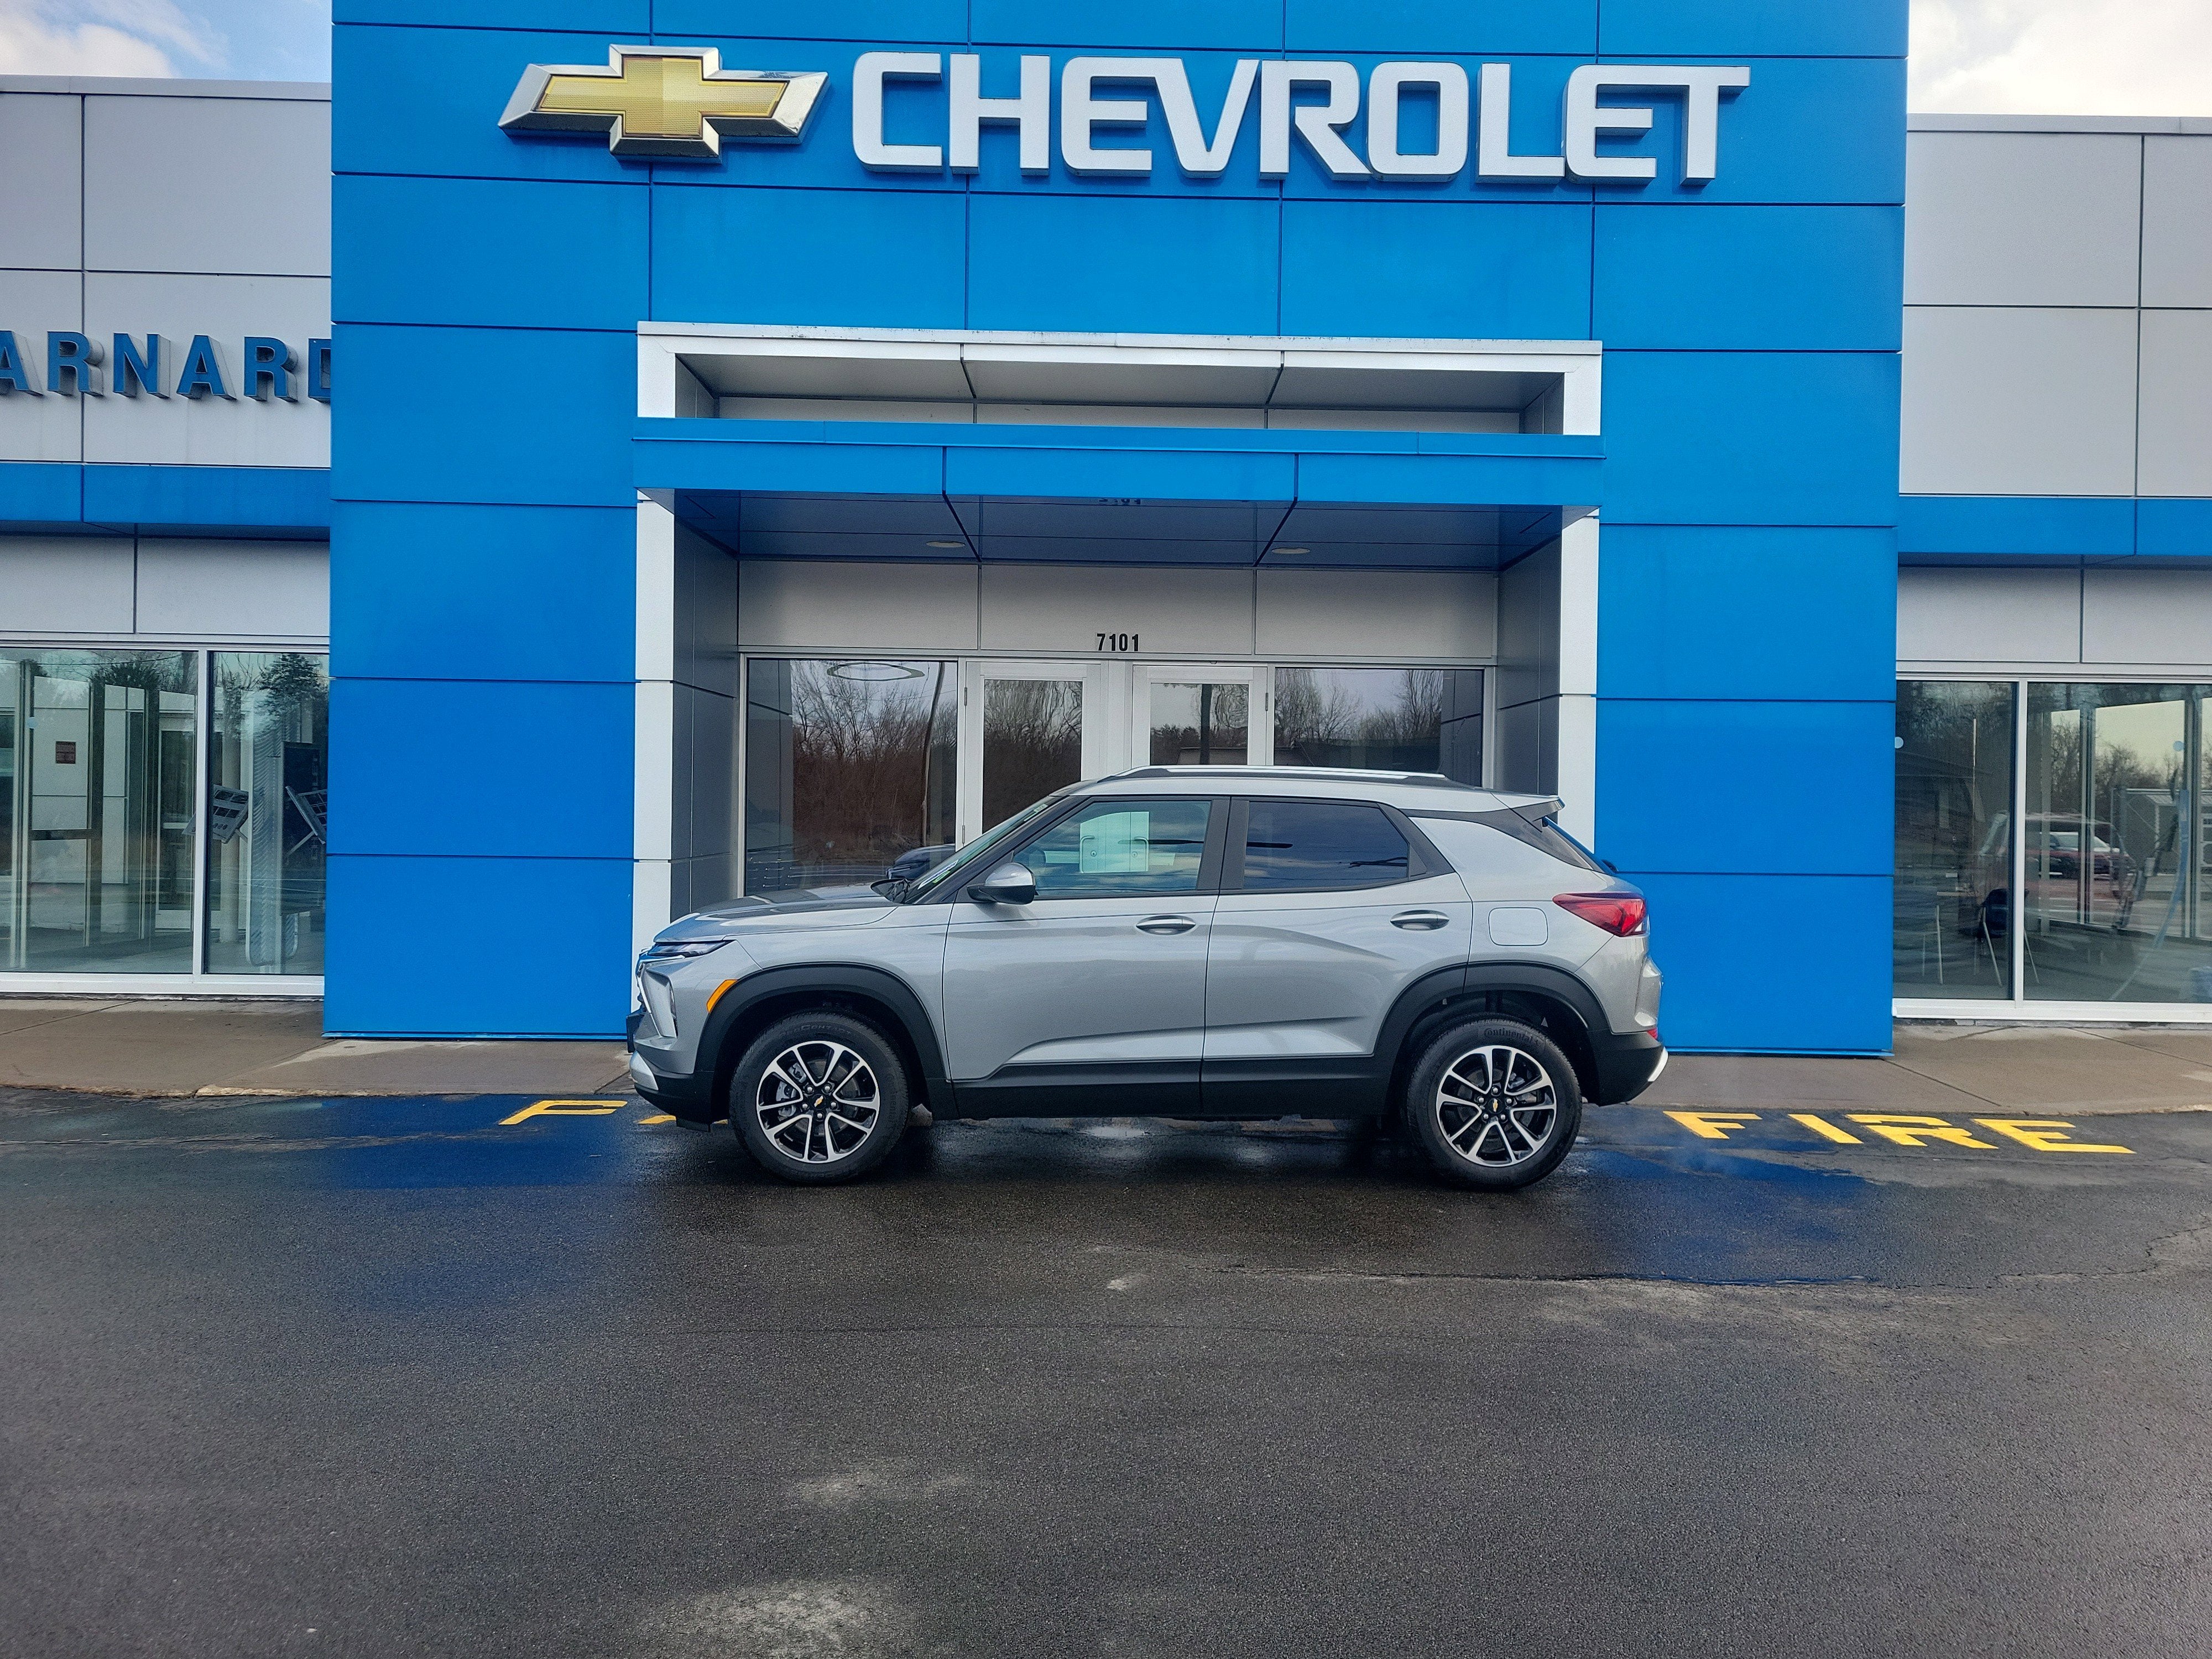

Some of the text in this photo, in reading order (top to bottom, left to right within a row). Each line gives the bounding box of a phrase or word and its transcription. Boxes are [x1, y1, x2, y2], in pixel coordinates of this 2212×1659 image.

[852, 51, 1750, 184] CHEVROLET
[1097, 633, 1139, 651] 7101
[1662, 1111, 2136, 1154] FIRE
